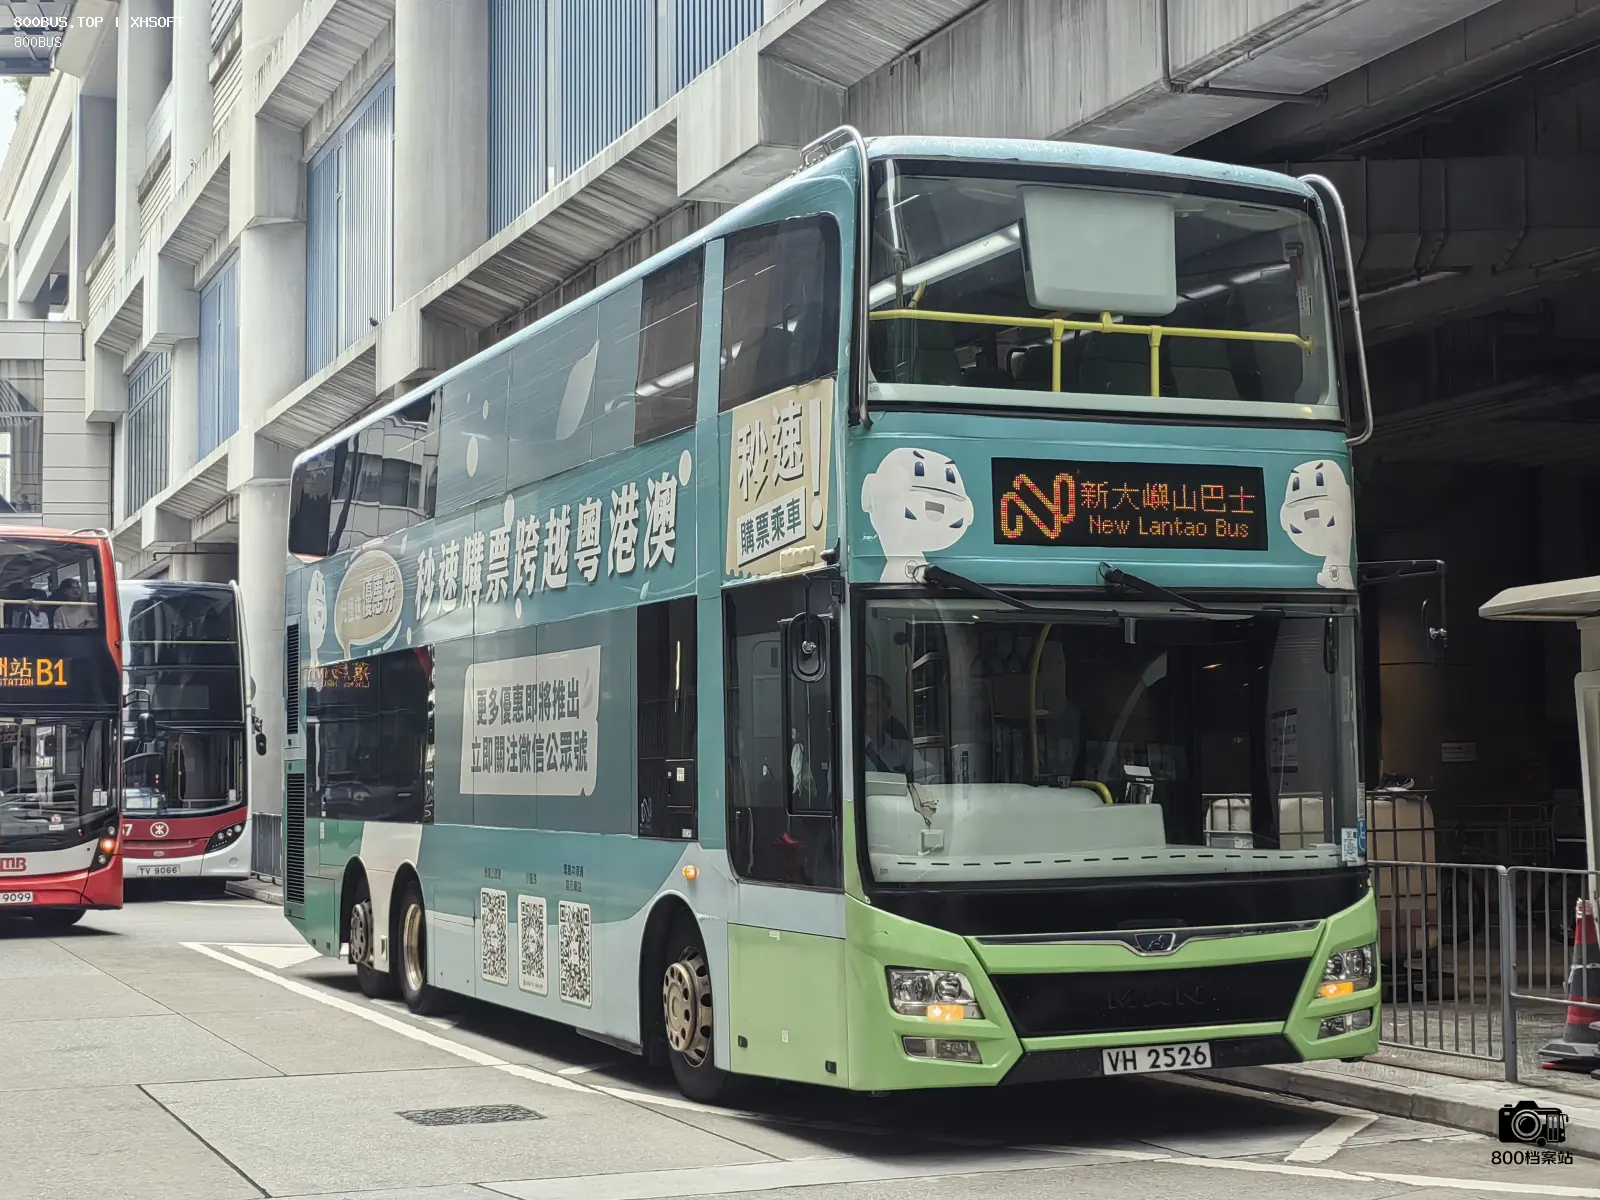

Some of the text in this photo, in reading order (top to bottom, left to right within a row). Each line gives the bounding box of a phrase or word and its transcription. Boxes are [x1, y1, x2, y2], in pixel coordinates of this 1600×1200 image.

[1080, 480, 1256, 513] 新大嶼山巴士
[740, 497, 802, 556] 購票乘車
[1089, 515, 1249, 538] New Lantao Bus
[414, 472, 678, 621] 秒速購票跨越粵港澳
[36, 658, 68, 686] B1
[476, 677, 580, 726] 更多優惠即將推出
[470, 729, 588, 774] 立即關注微信公眾號
[122, 823, 133, 837] 7
[0, 857, 27, 872] MB
[2, 892, 31, 902] 9099
[1107, 1045, 1207, 1072] VH 2526
